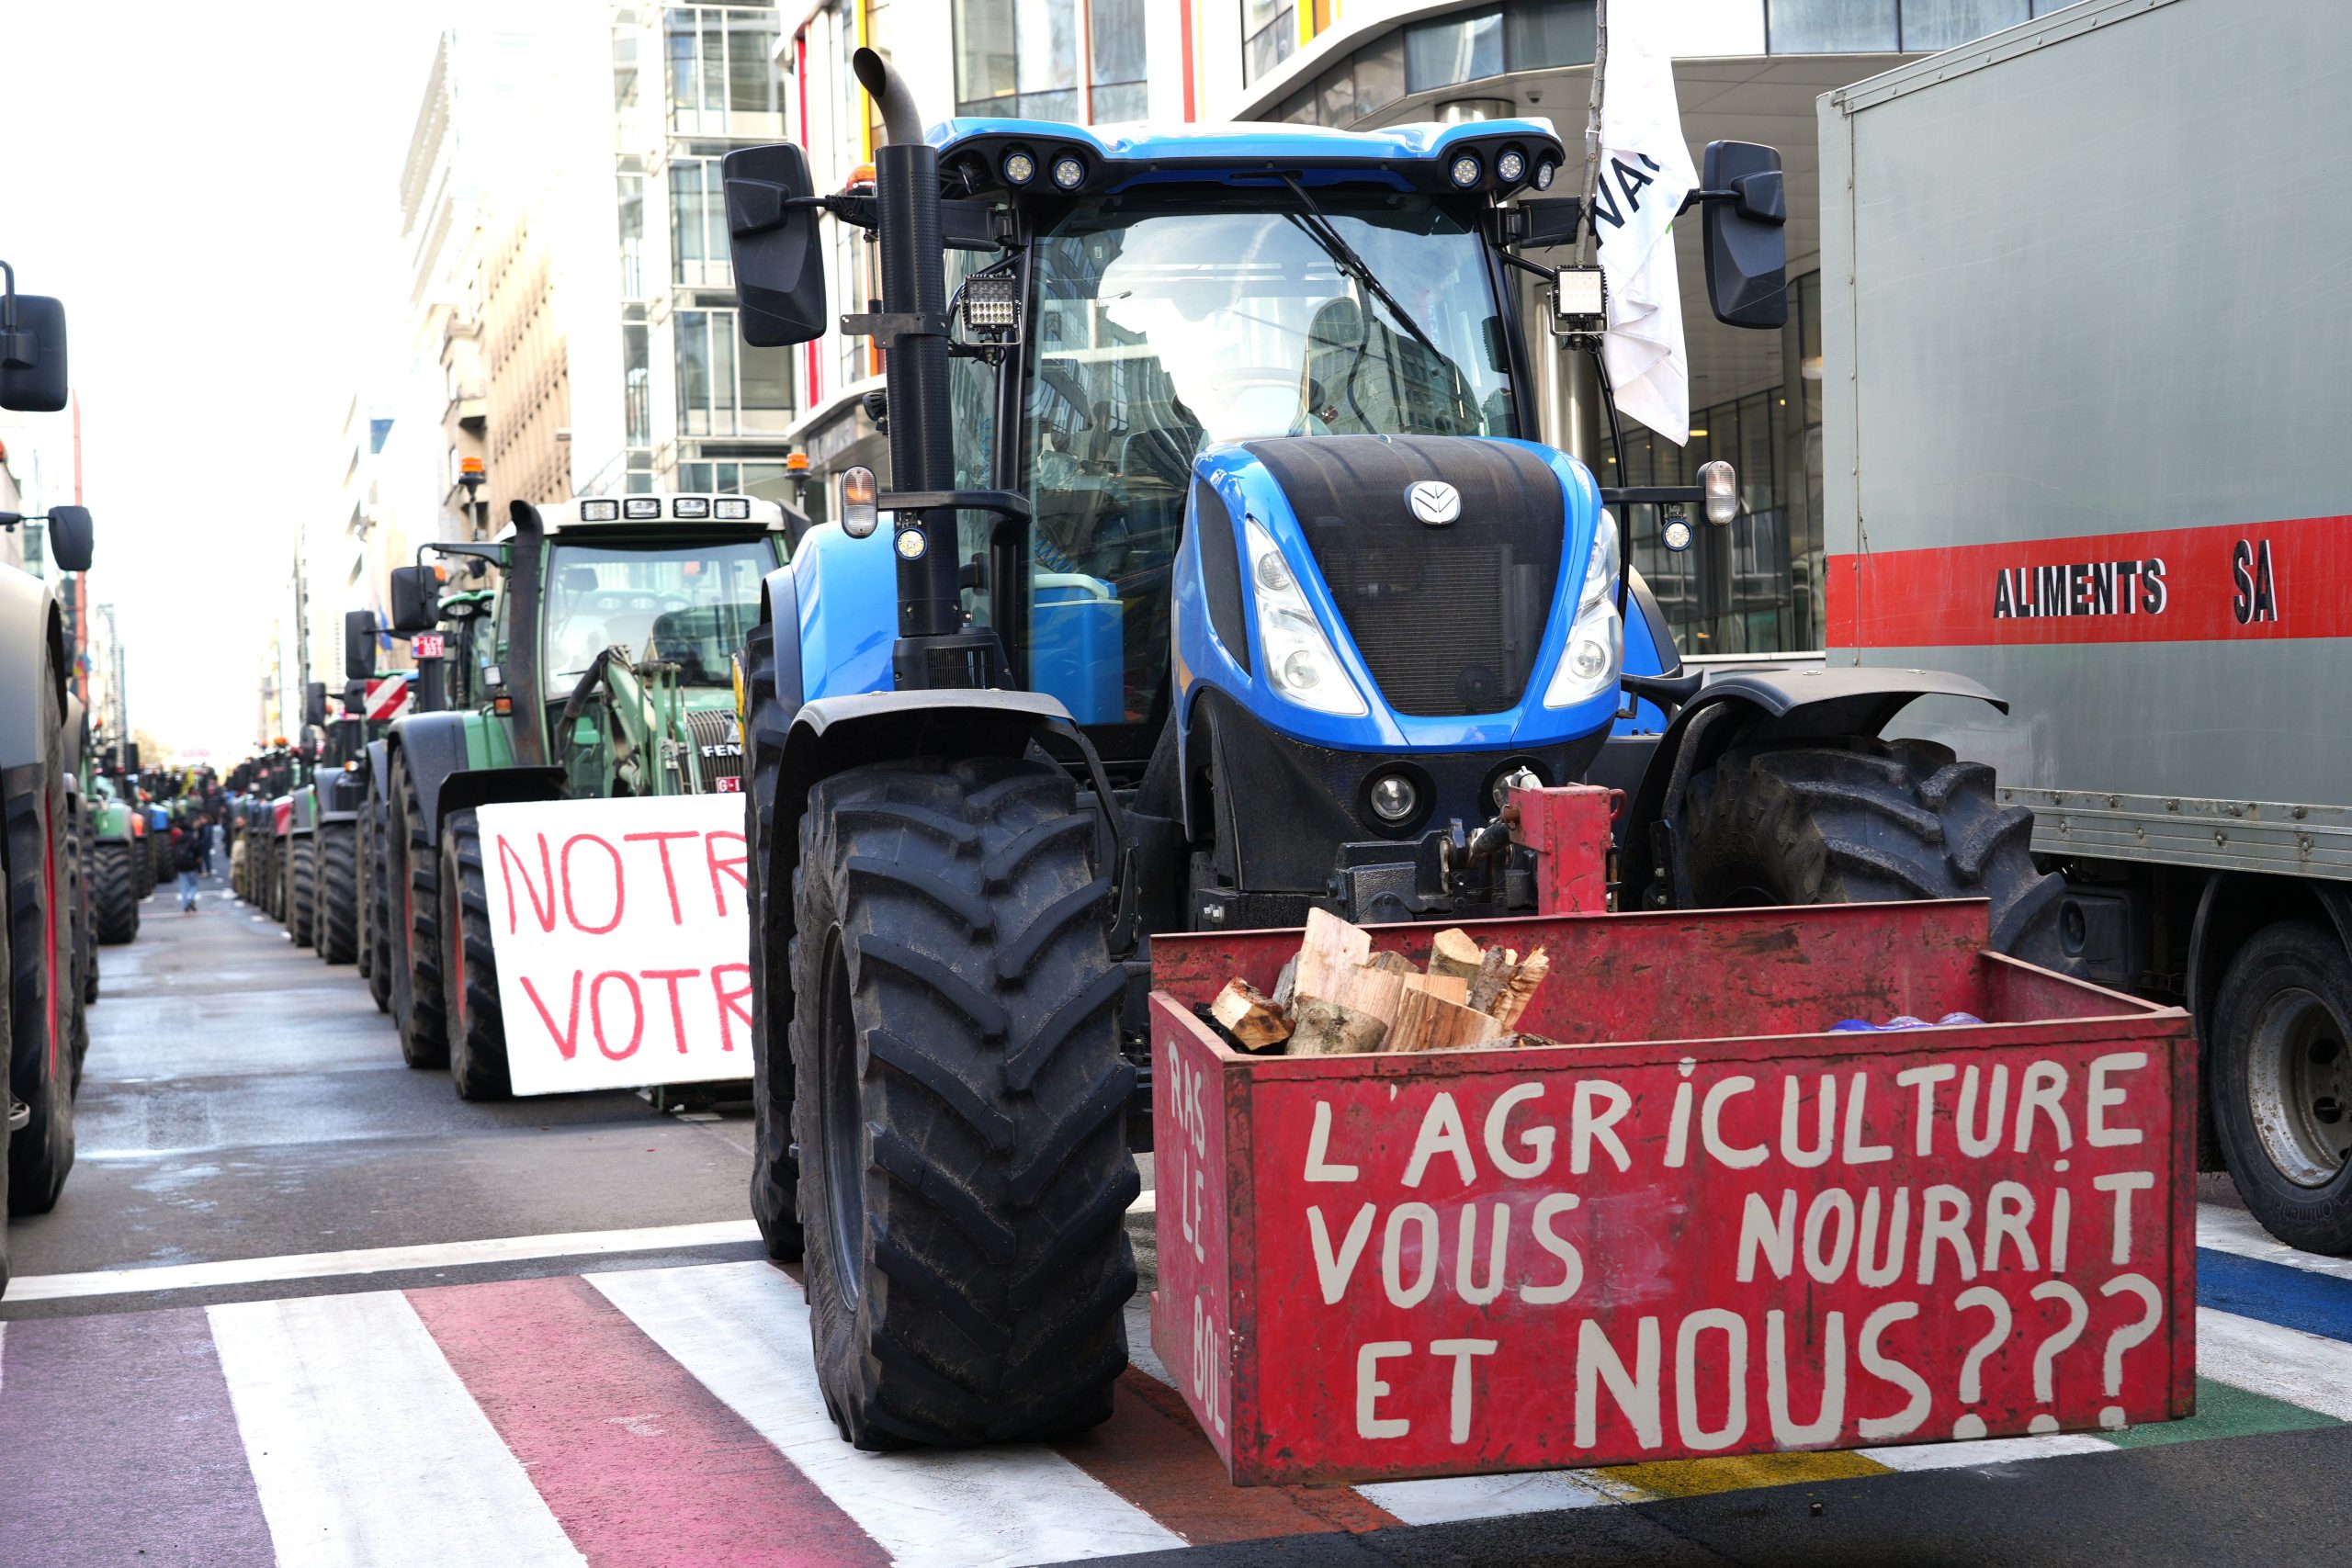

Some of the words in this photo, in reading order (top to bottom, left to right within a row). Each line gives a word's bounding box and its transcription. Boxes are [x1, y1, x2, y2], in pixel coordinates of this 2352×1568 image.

[1993, 558, 2167, 618] ALIMENTS
[2233, 538, 2278, 625] SA
[701, 742, 742, 758] FEN
[497, 830, 746, 934] NOTR
[520, 963, 752, 1061] VOTR
[1169, 1040, 1205, 1159] RAS
[1182, 1148, 1204, 1264] LE
[1306, 1193, 1584, 1308] VOUS
[1194, 1293, 1226, 1438] BOL
[1356, 1338, 1498, 1445] ET
